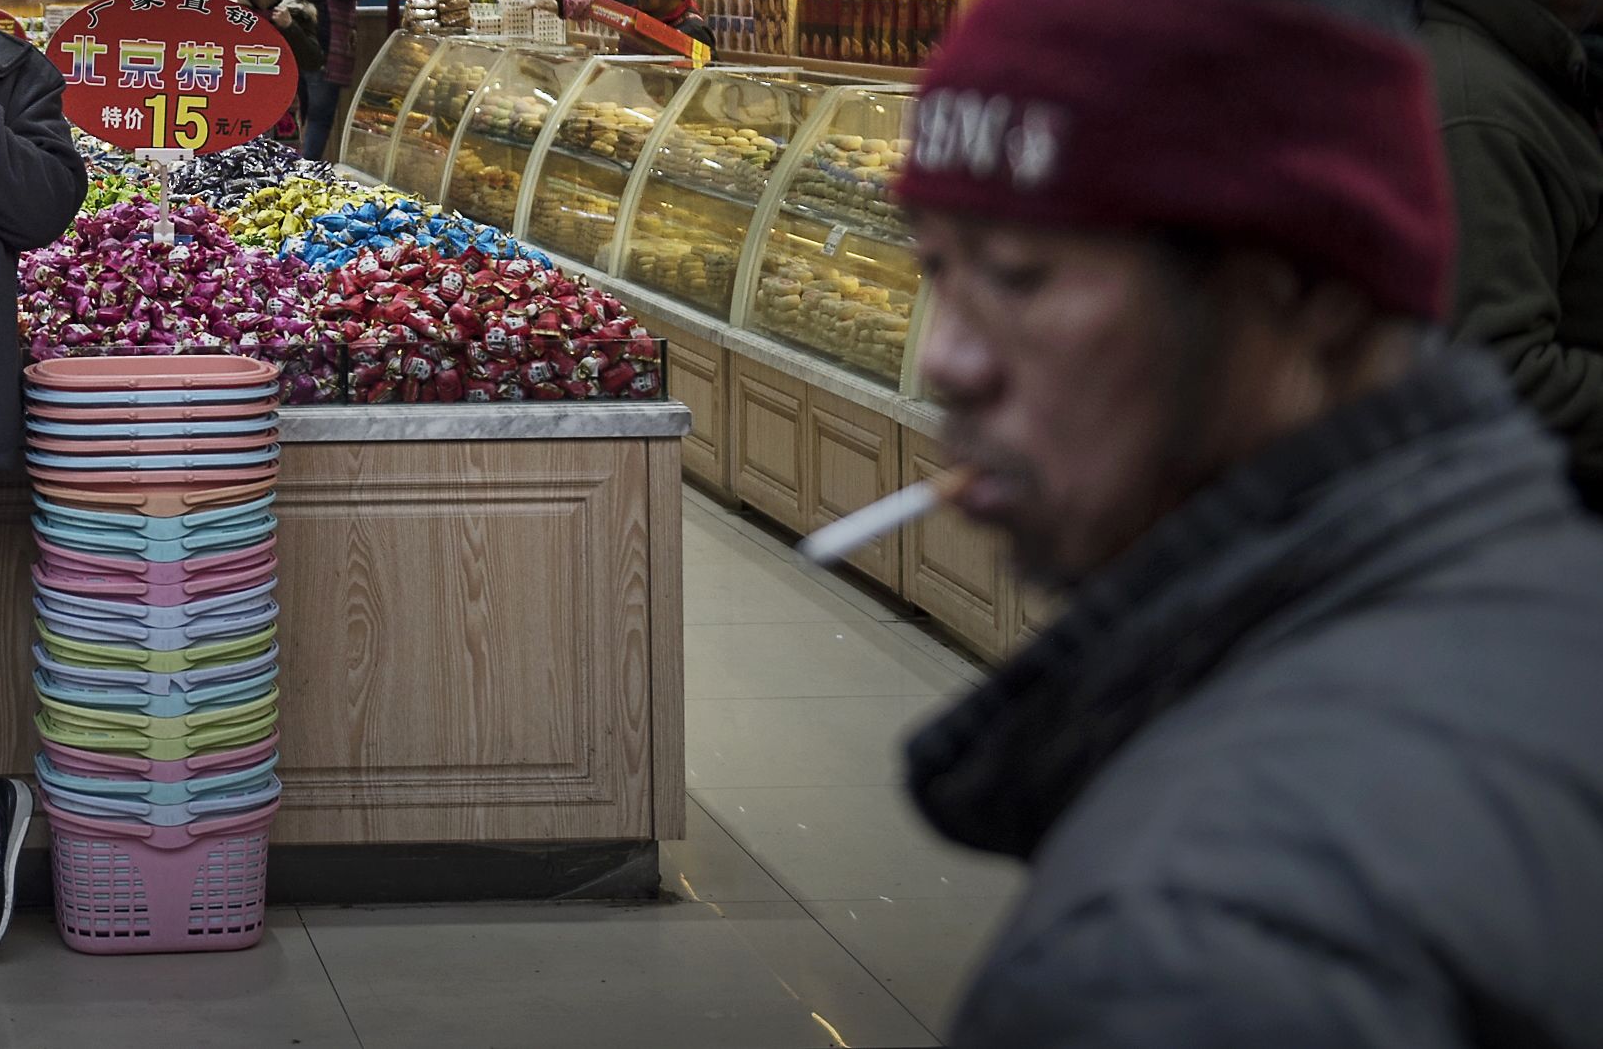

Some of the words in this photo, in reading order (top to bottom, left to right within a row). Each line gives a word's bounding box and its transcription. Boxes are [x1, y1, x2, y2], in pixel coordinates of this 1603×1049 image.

[59, 34, 282, 95] 北京特产
[100, 105, 145, 131] 特价
[144, 93, 210, 150] 15
[214, 116, 254, 137] 元/斤
